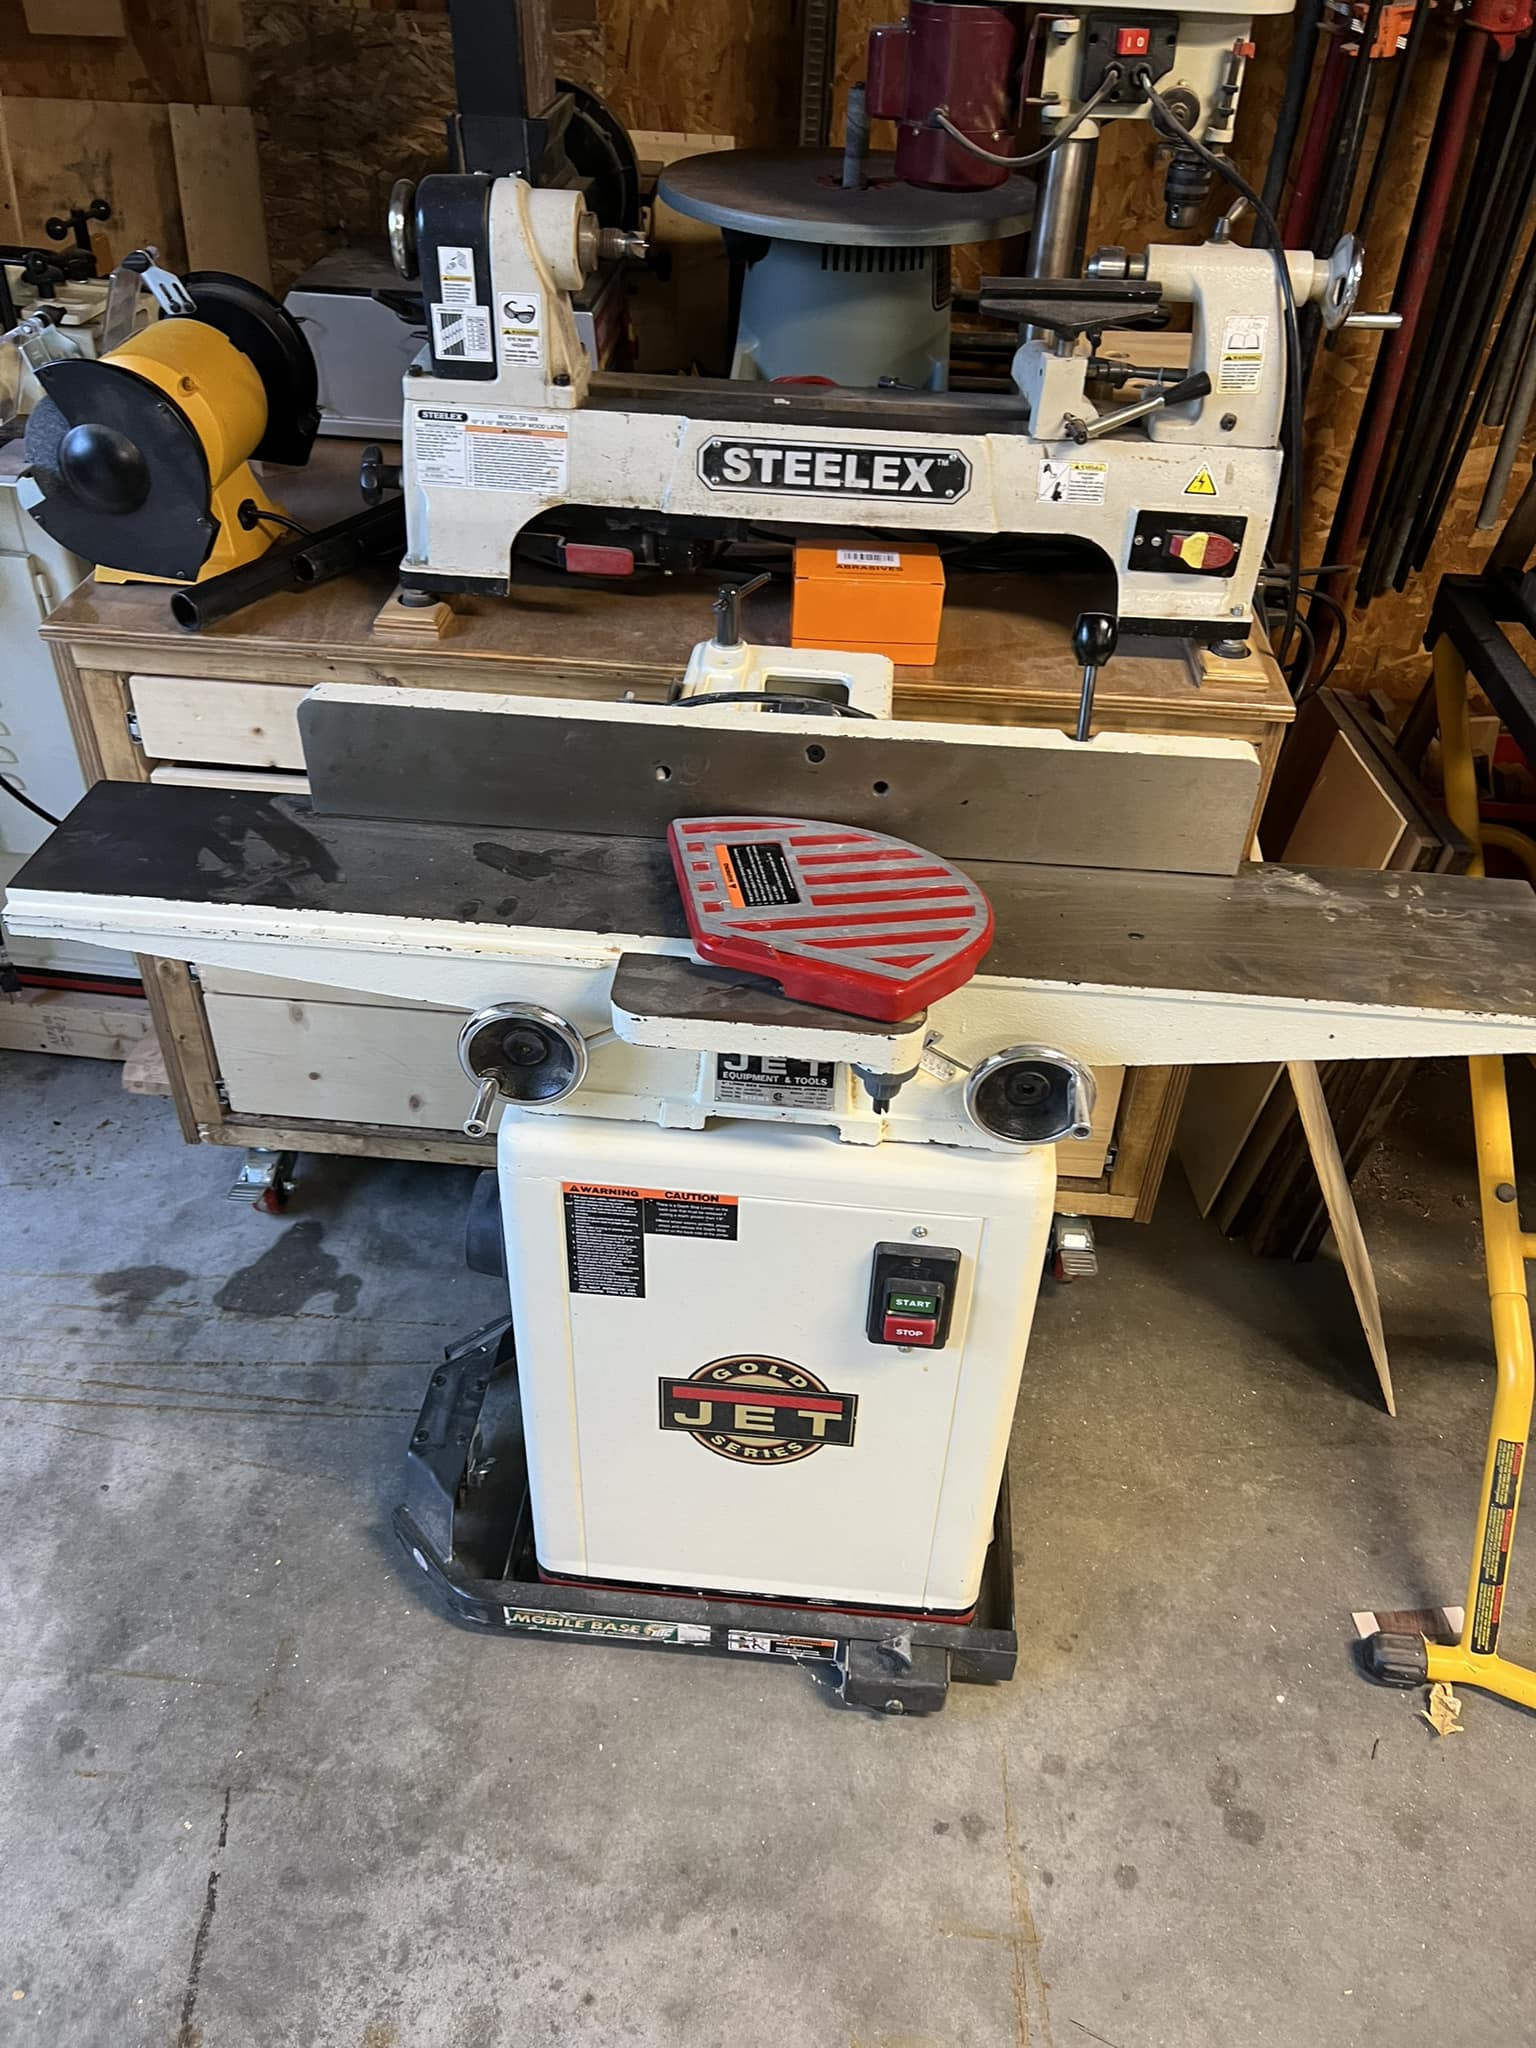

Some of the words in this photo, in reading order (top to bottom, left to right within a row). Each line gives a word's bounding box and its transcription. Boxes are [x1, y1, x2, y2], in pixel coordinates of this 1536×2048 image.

[421, 411, 465, 421] STEELEX
[722, 447, 935, 493] STEELEX
[723, 1055, 819, 1077] JET
[722, 1071, 780, 1083] EQUIPMENT
[784, 1076, 792, 1084] &
[794, 1077, 828, 1086] TOOLS
[580, 1186, 640, 1197] WARNING
[665, 1191, 720, 1203] CAUTION
[895, 1298, 932, 1309] START
[895, 1328, 924, 1337] STOP
[711, 1362, 808, 1388] GOLD
[673, 1401, 843, 1437] JET
[711, 1434, 803, 1459] SERIES
[512, 1612, 585, 1629] MOBILE
[590, 1619, 641, 1634] BASE
